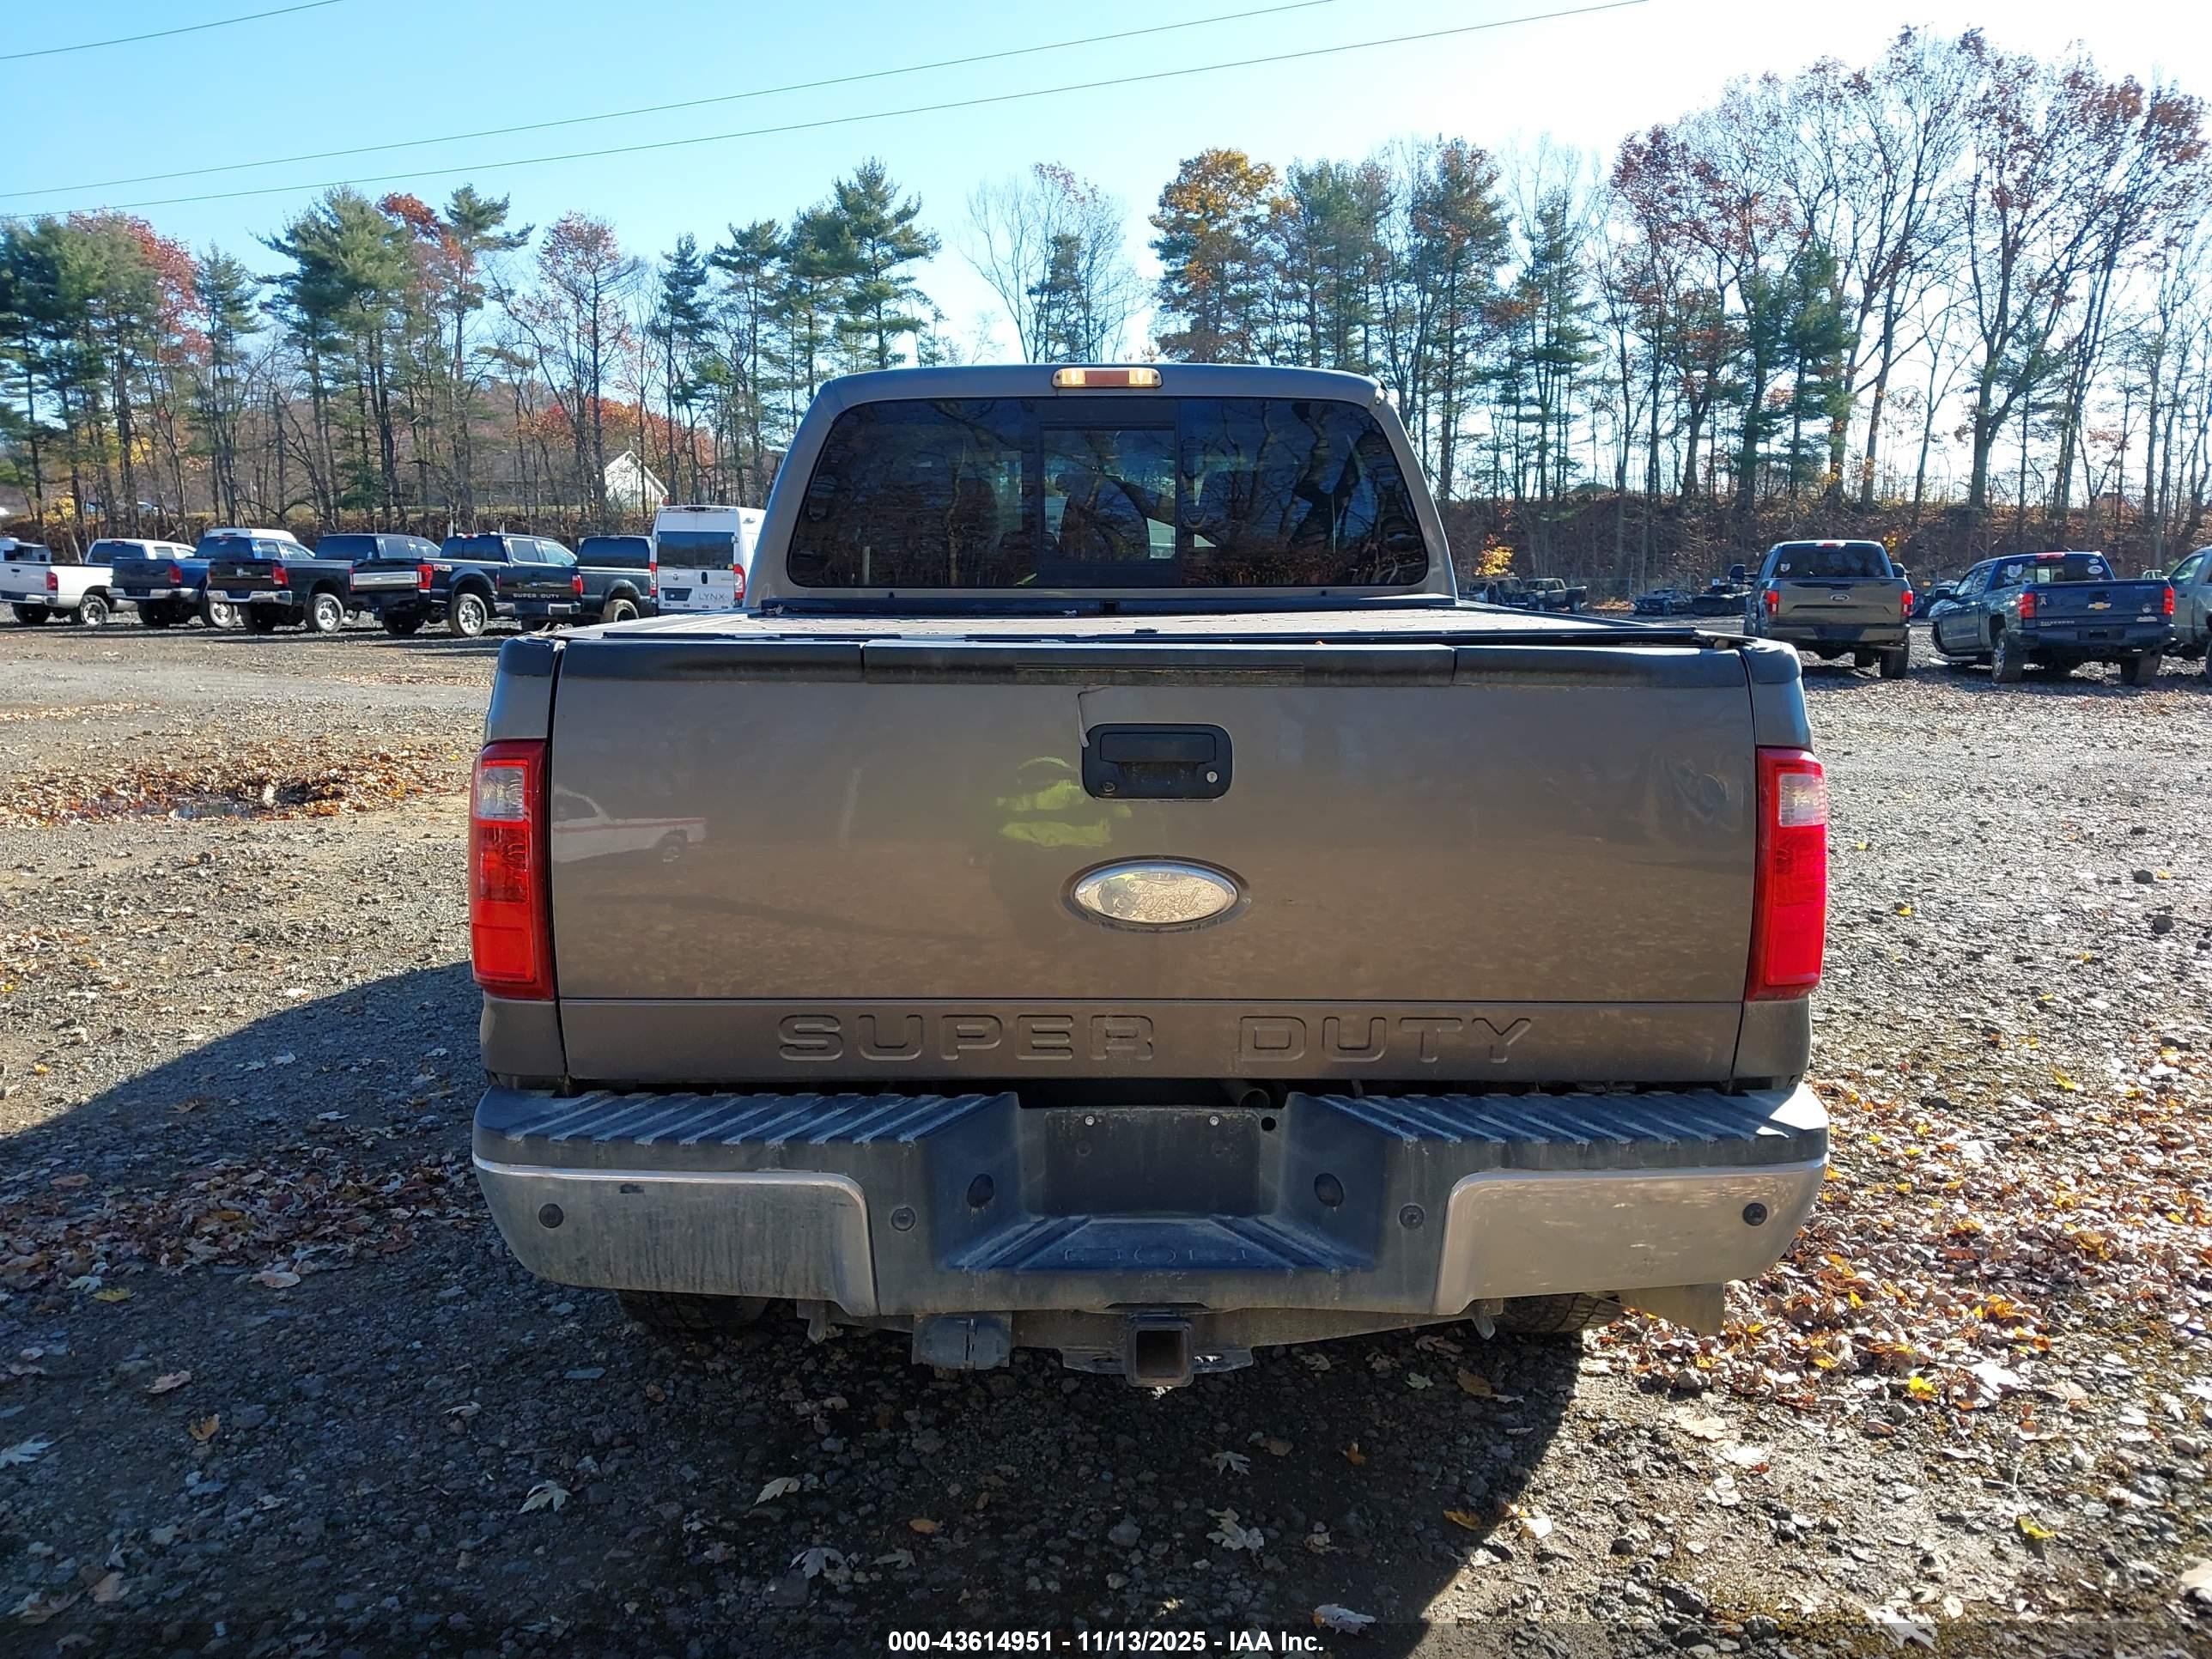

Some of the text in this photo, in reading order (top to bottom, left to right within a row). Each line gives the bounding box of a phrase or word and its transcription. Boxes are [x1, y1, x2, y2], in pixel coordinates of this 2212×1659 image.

[698, 592, 726, 601] LYNX
[778, 1013, 1533, 1064] SUPER DUTY
